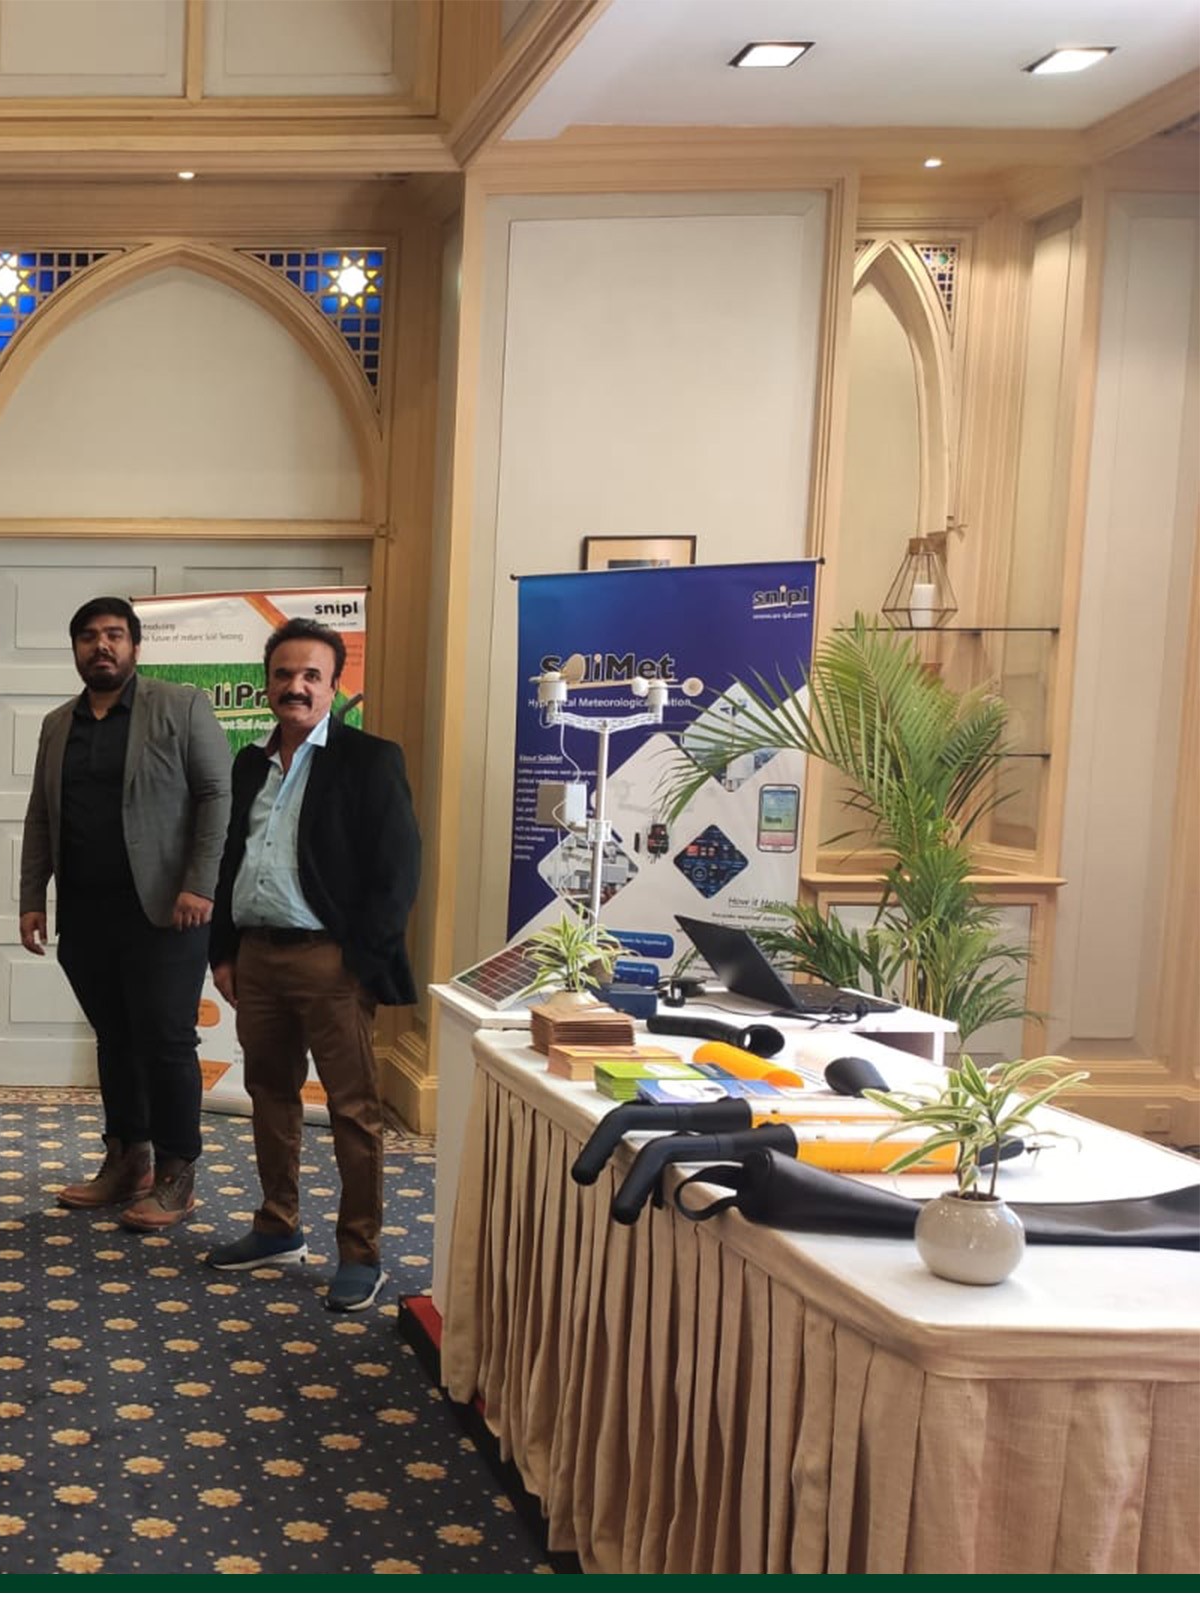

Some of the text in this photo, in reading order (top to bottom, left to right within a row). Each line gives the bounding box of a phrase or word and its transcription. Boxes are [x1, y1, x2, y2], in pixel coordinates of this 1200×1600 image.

[753, 585, 809, 608] snipl
[314, 601, 358, 618] snipl
[540, 652, 676, 682] SliMet
